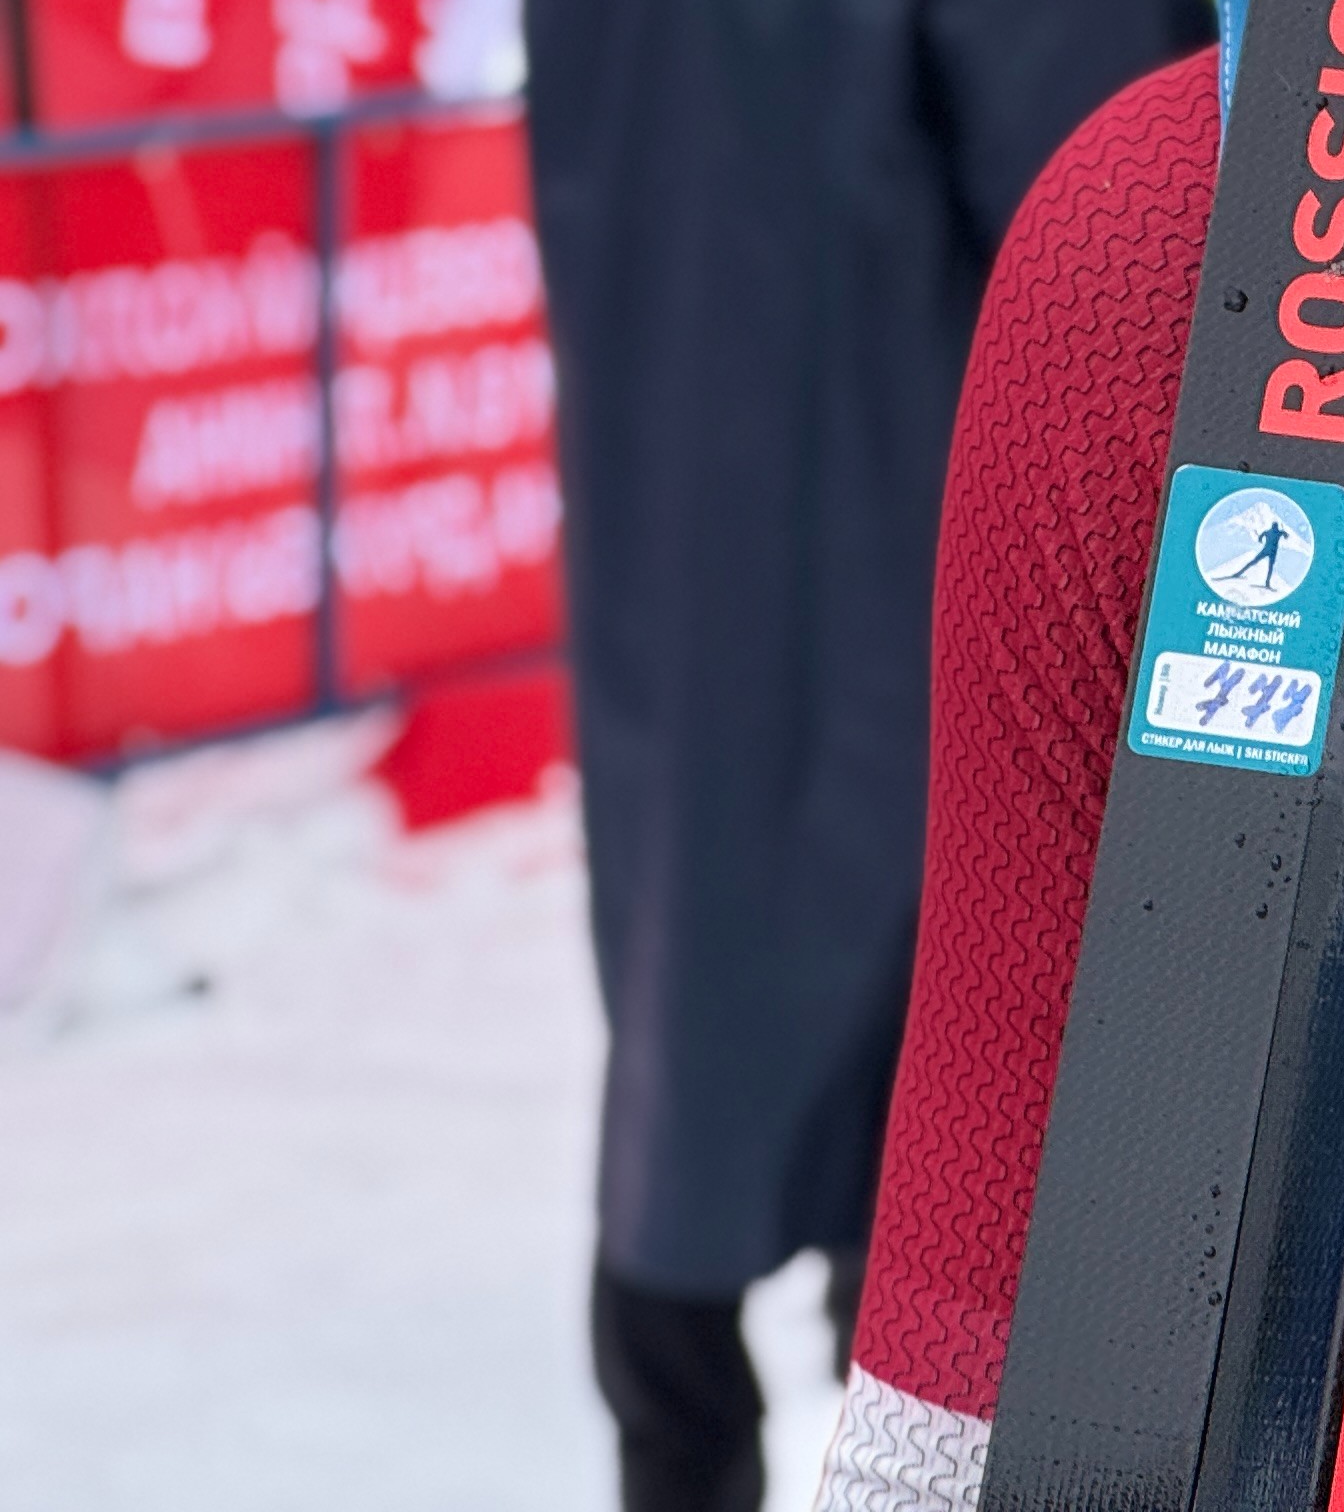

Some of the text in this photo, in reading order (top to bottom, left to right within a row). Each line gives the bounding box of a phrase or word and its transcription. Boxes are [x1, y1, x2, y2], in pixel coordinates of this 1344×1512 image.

[1207, 621, 1285, 645] ЛЫЖНЫЙ
[1203, 642, 1282, 665] МАРАФОН
[1141, 732, 1184, 749] СТИКЕР
[1183, 738, 1207, 752] ДЛЯ
[1207, 741, 1235, 757] ЛЫЖ
[1244, 746, 1263, 761] SKI
